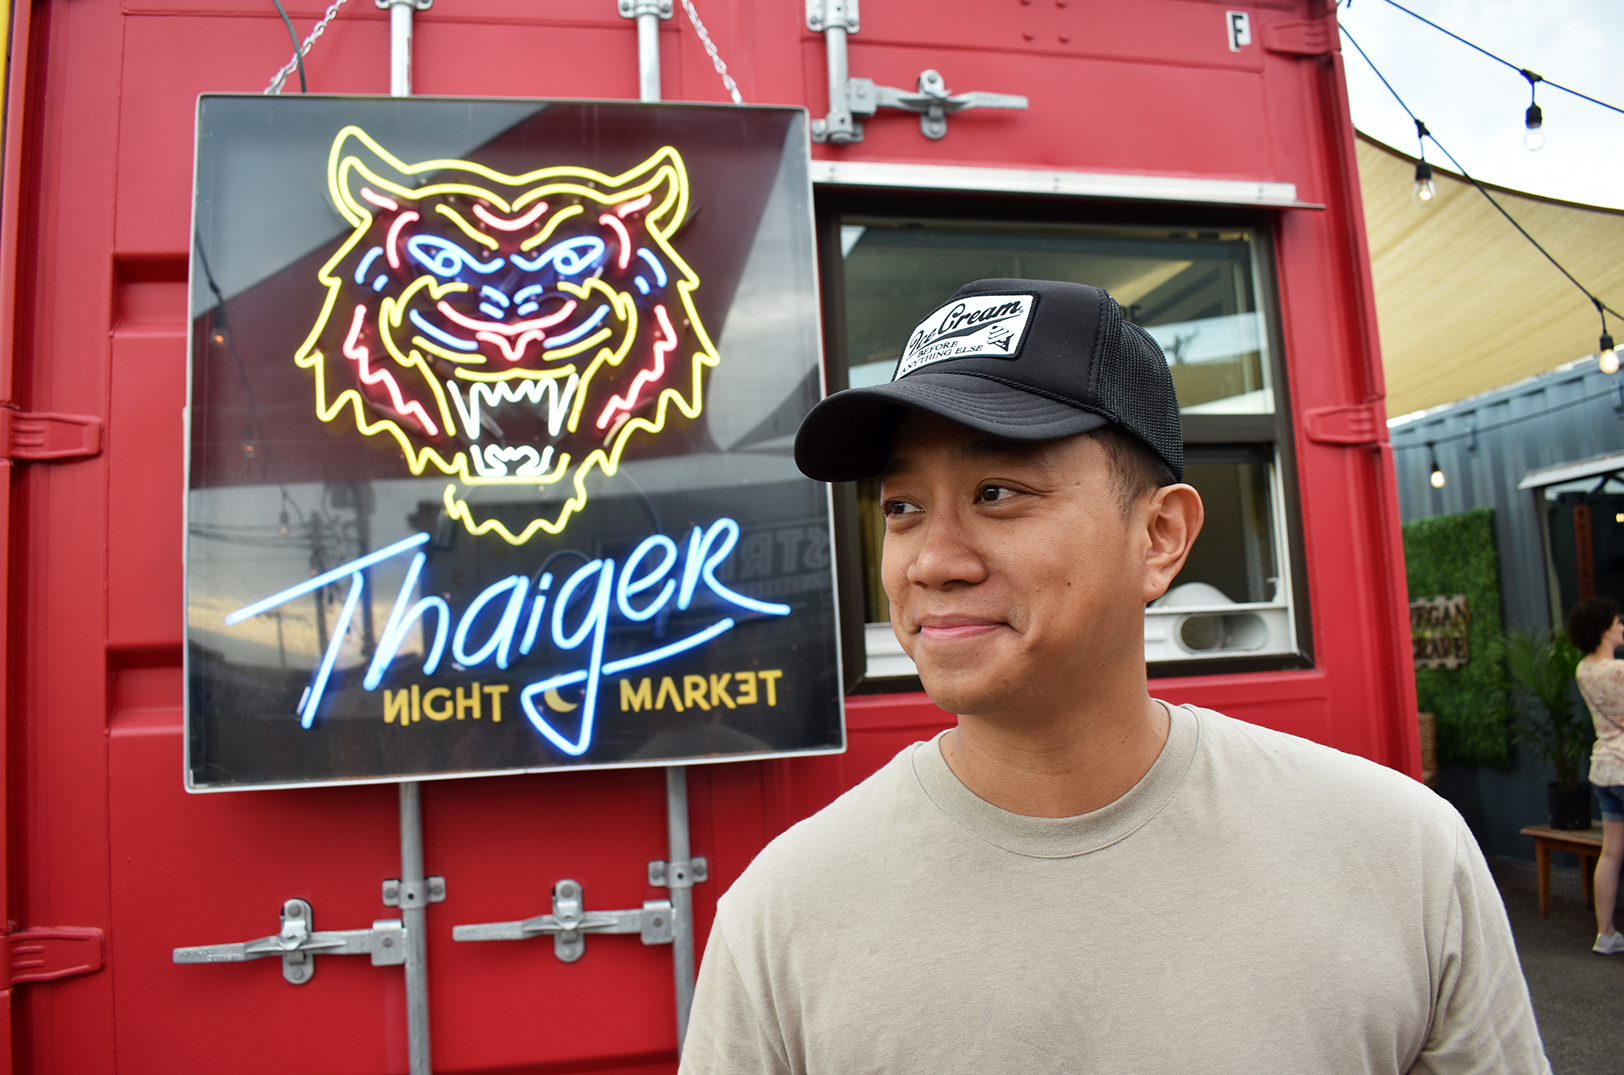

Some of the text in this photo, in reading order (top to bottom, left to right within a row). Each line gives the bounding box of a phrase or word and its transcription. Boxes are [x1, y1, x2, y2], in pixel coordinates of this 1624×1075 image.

[1231, 14, 1244, 48] F
[909, 301, 1023, 356] Ice Cream
[900, 345, 984, 375] ANYTHING ELSE
[917, 341, 958, 358] BEFORE
[383, 670, 782, 726] NIGHT MARKET
